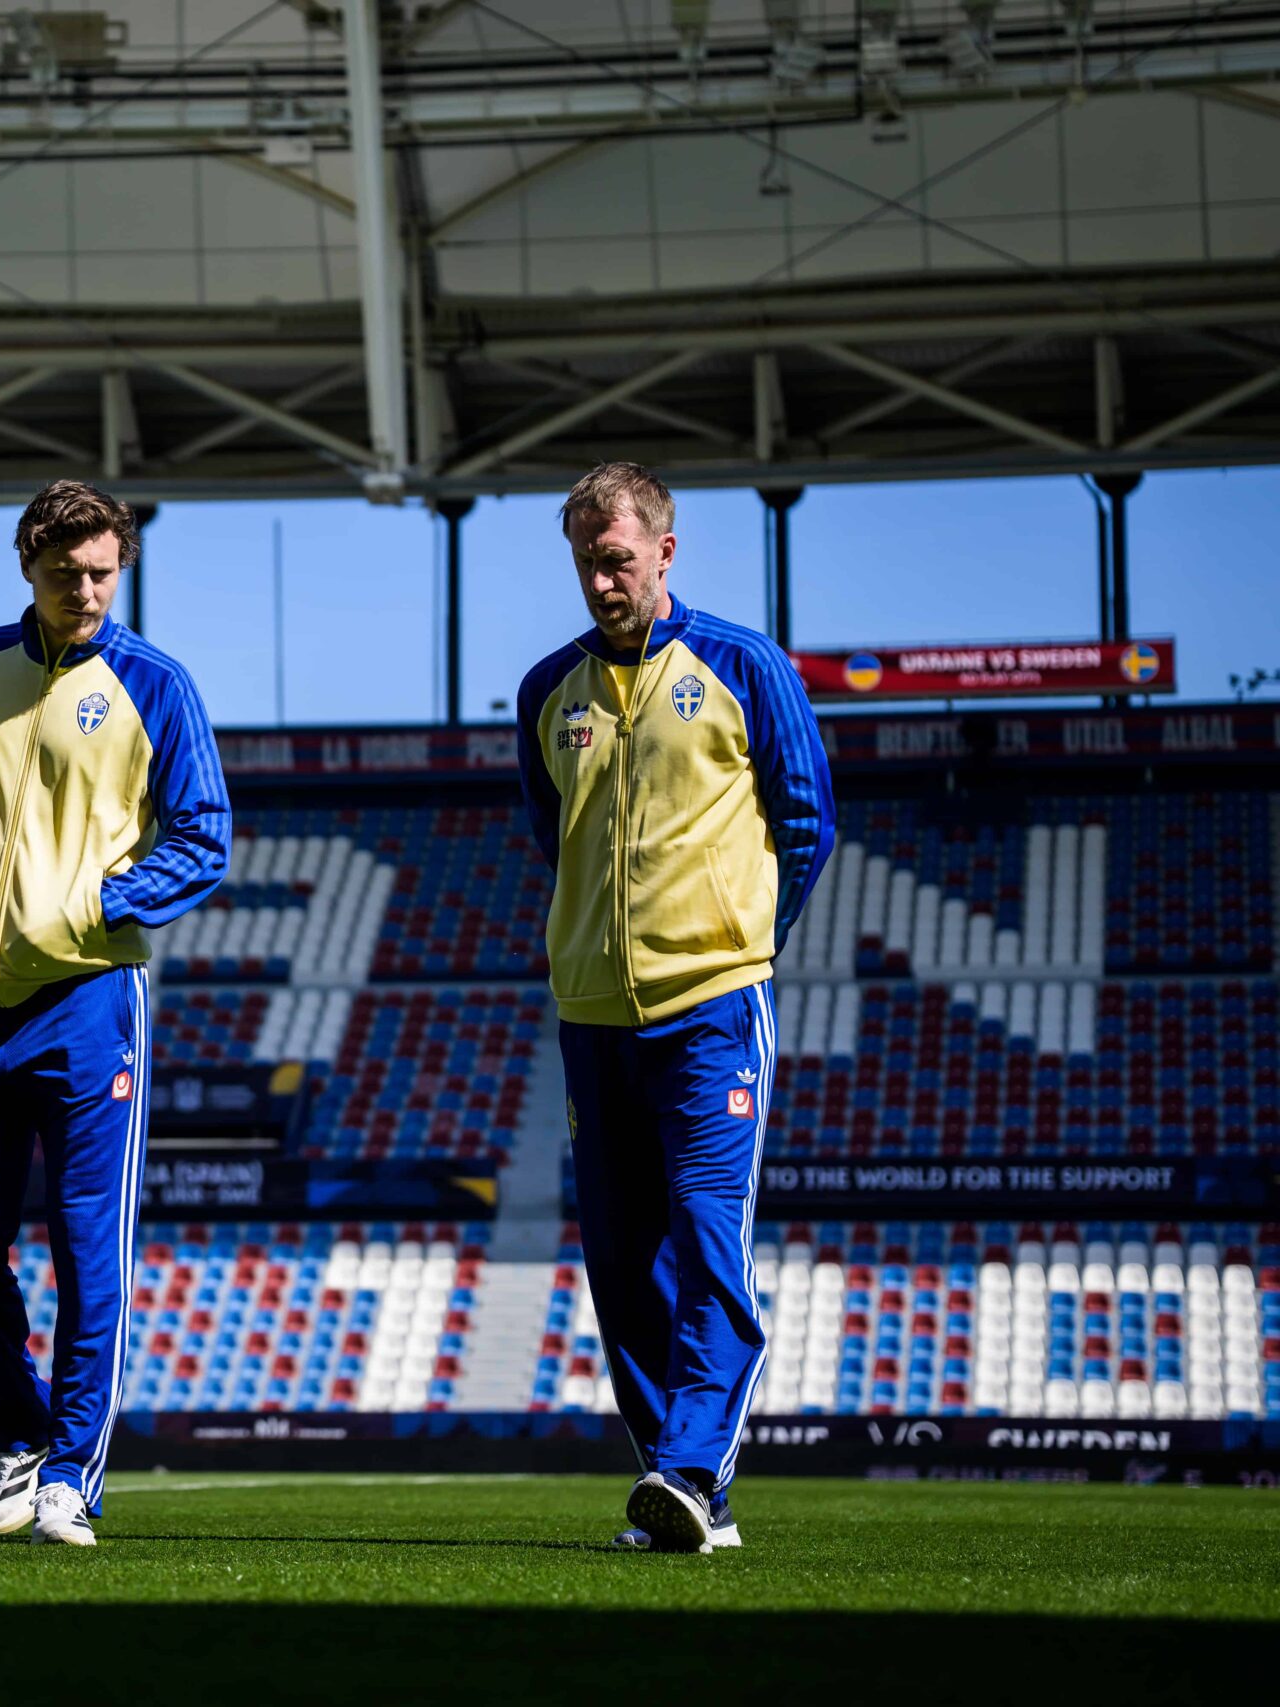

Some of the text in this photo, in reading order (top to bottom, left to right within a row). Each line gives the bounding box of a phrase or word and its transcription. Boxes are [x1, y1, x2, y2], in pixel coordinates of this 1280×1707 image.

[900, 649, 1101, 674] UKRAINE VS SWEDEN
[765, 1166, 1175, 1191] TO THE WORLD FOR THE SUPPORT
